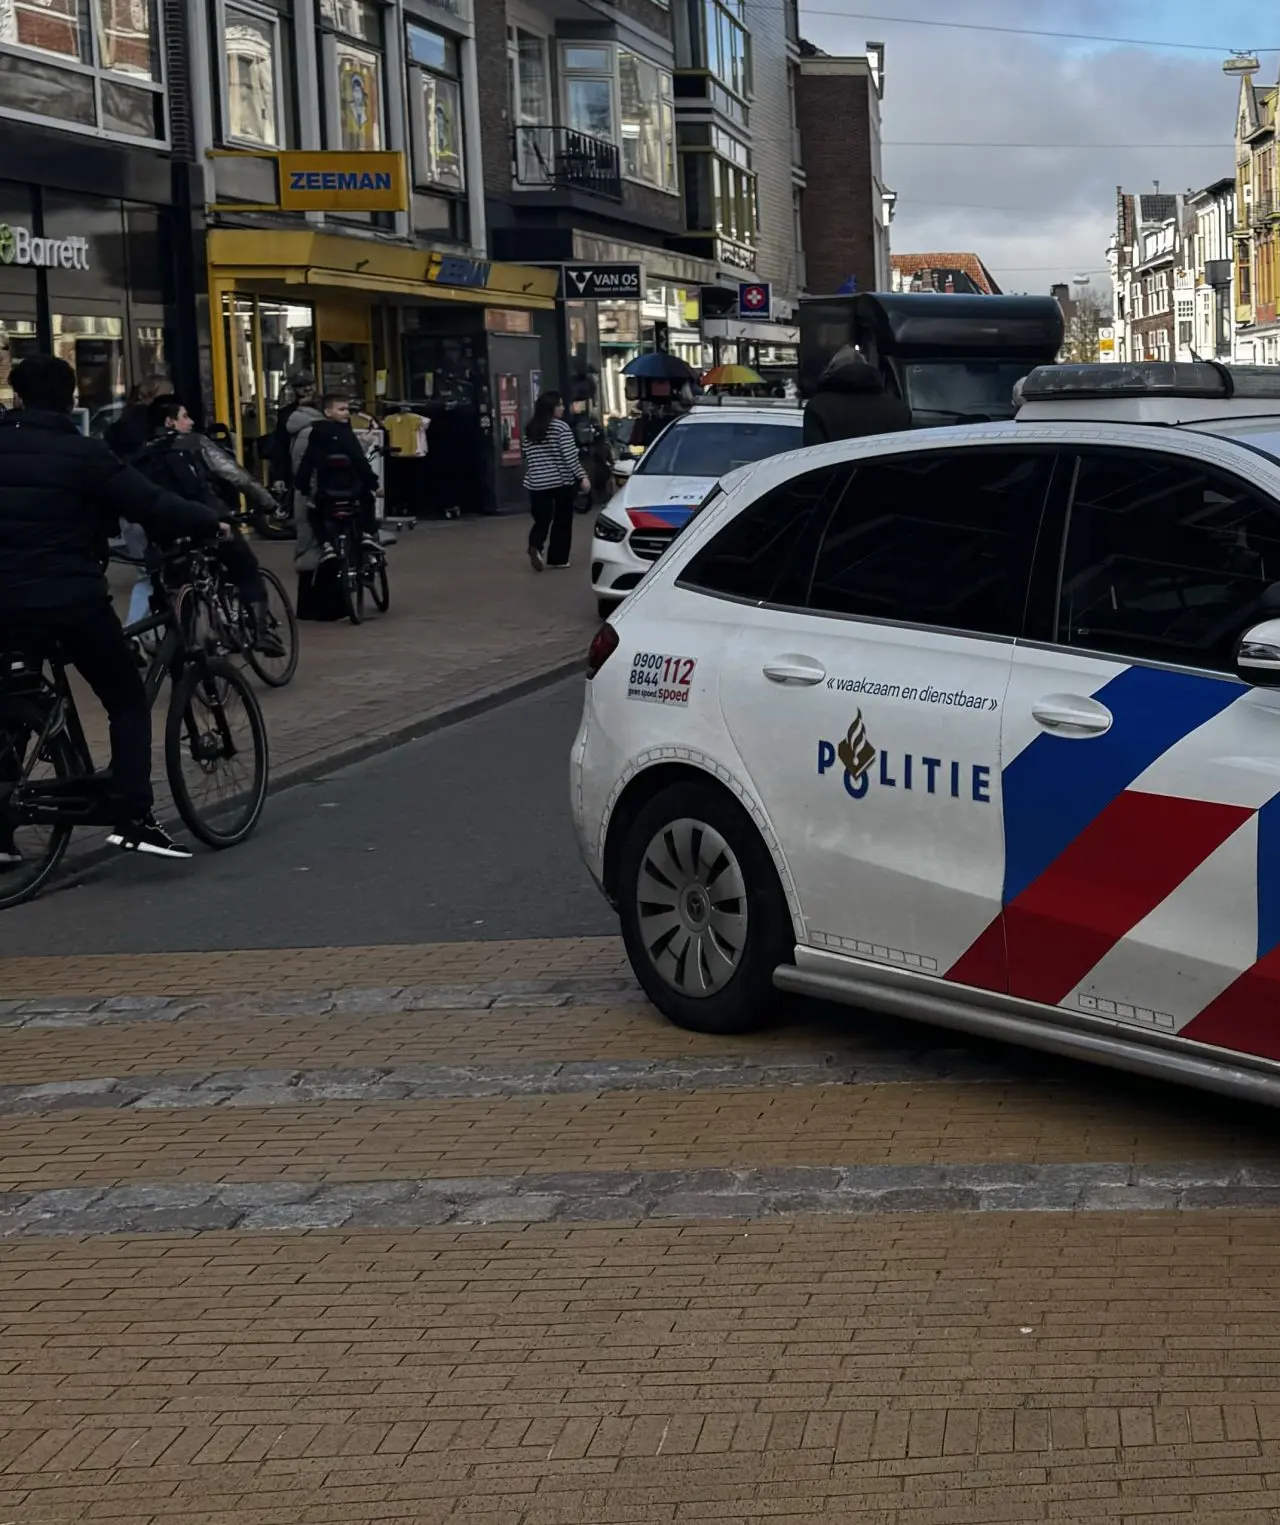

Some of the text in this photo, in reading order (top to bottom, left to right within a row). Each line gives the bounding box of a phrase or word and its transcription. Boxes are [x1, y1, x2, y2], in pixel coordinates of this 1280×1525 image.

[290, 172, 391, 190] ZEEMAN
[16, 226, 90, 270] Barrett
[593, 273, 638, 286] VAN OS
[629, 669, 658, 686] 8844
[633, 653, 695, 685] 0900 112
[658, 688, 690, 703] spoed
[836, 677, 901, 698] waakzaam
[901, 687, 918, 700] en
[918, 685, 989, 710] dienstbaar
[817, 740, 990, 803] POLITIE
